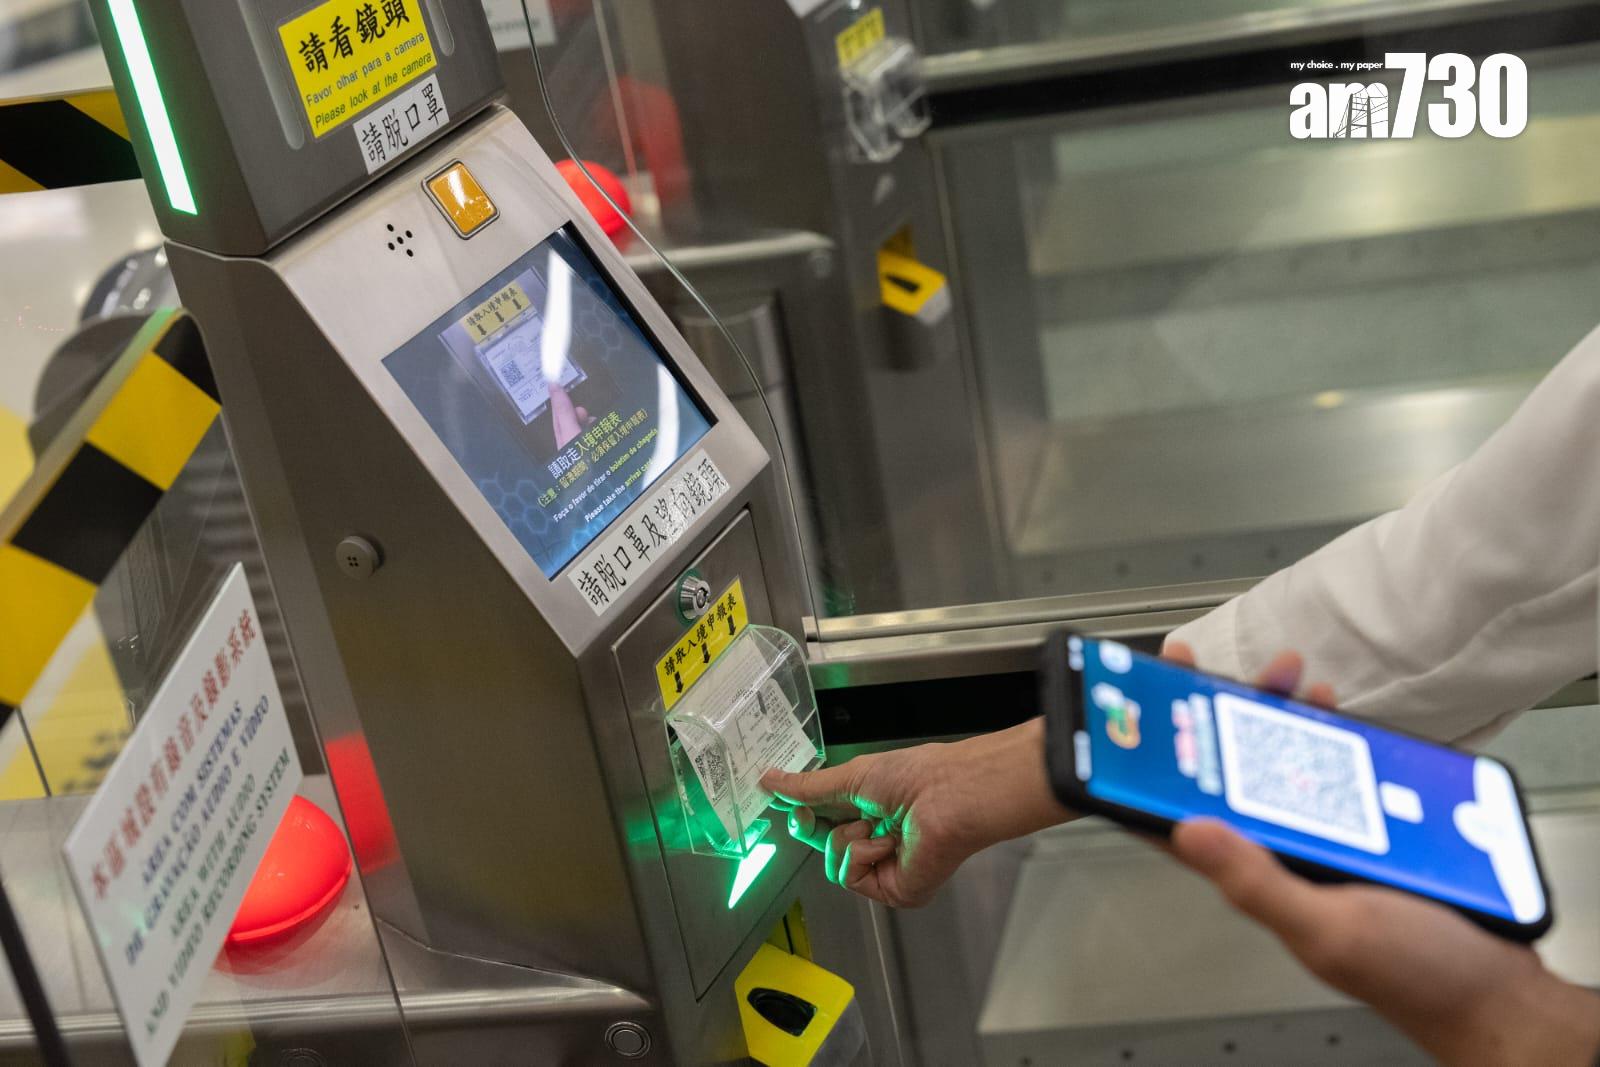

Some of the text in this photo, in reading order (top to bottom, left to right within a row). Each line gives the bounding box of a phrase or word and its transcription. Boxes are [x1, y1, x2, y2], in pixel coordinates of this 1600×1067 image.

[299, 0, 410, 74] 請看鏡頭
[306, 32, 425, 107] Favor olhar para a camera
[315, 51, 432, 129] Please look at the camera
[553, 508, 569, 523] Faça
[572, 490, 588, 506] favor
[587, 484, 595, 493] de
[594, 473, 606, 487] tirar
[609, 453, 630, 472] boletim
[629, 447, 637, 455] de
[584, 504, 604, 522] Please
[602, 493, 616, 506] take
[614, 484, 626, 495] the
[625, 468, 642, 487] arrival
[663, 592, 737, 677] 請取入境申報表
[171, 783, 198, 834] COM
[197, 699, 244, 788] SISTEMAS
[231, 746, 242, 769] E
[198, 829, 226, 883] WITH
[226, 772, 256, 832] AUDIO
[201, 815, 257, 925] RECORDING
[256, 746, 291, 819] SYSTEM
